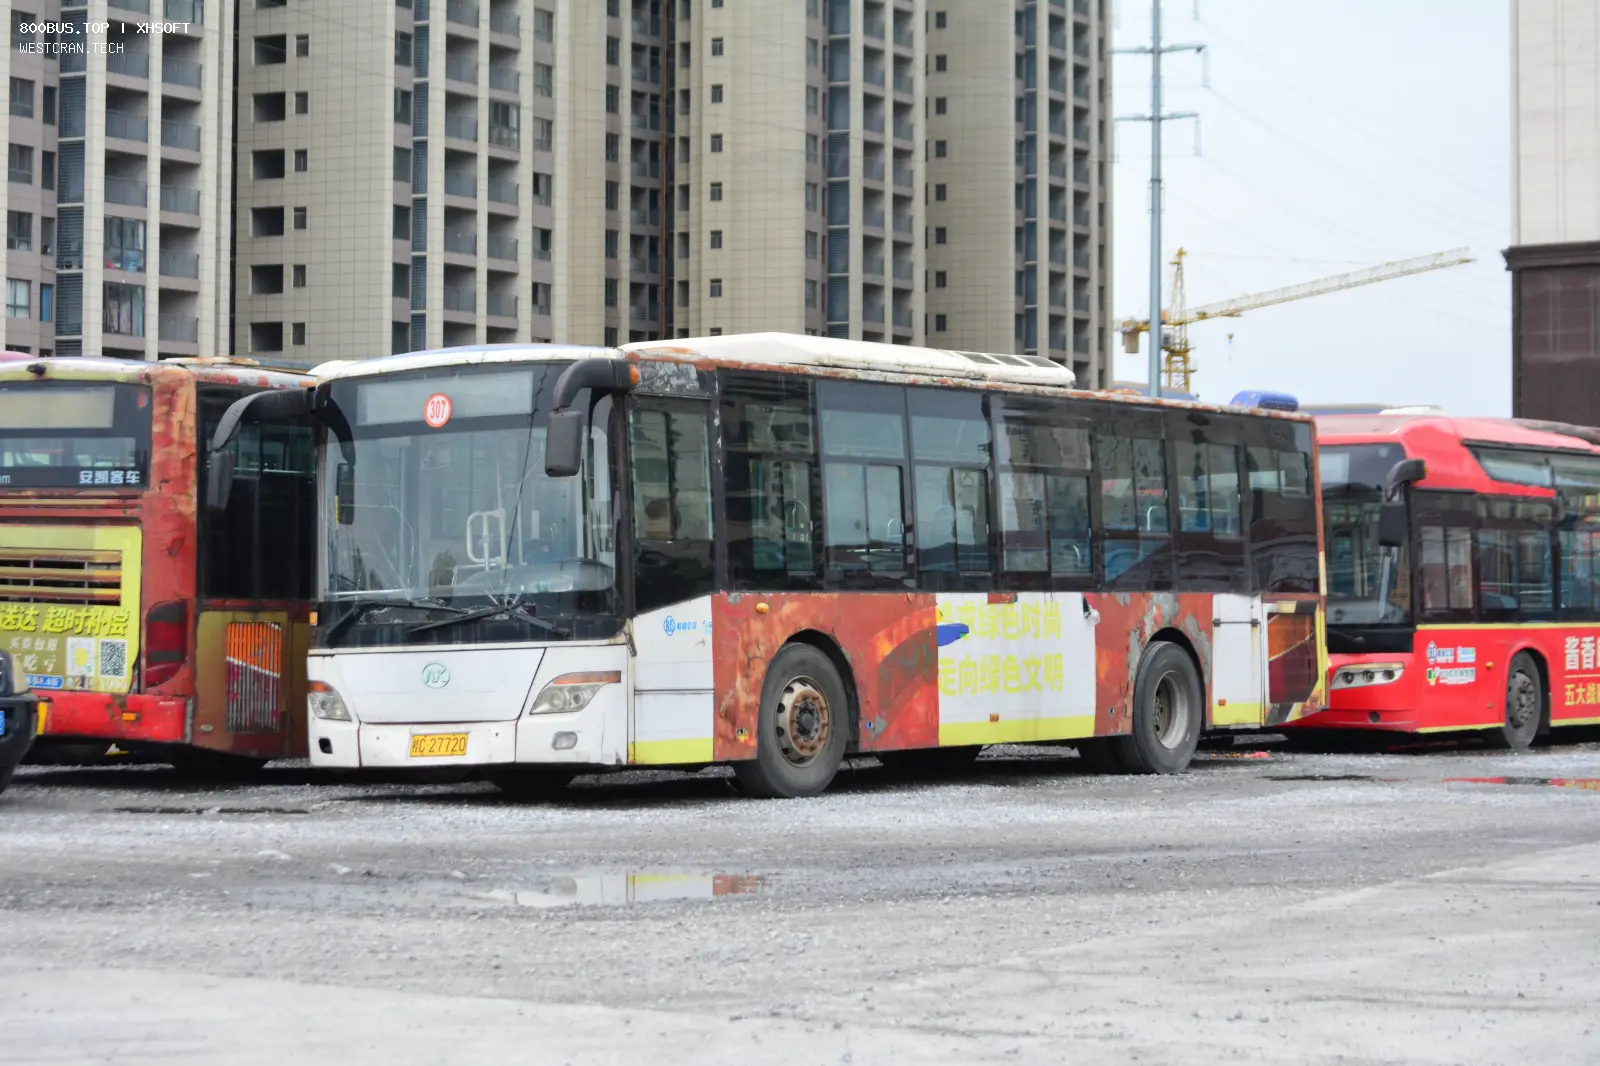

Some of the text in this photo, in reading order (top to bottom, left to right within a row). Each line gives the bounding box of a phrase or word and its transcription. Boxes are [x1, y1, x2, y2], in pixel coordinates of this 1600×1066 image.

[430, 399, 447, 420] 307
[79, 470, 140, 484] 安凯客车
[42, 606, 130, 637] 超时补偿
[1564, 635, 1600, 671] 酱香
[938, 652, 1063, 697] 走向绿色文明
